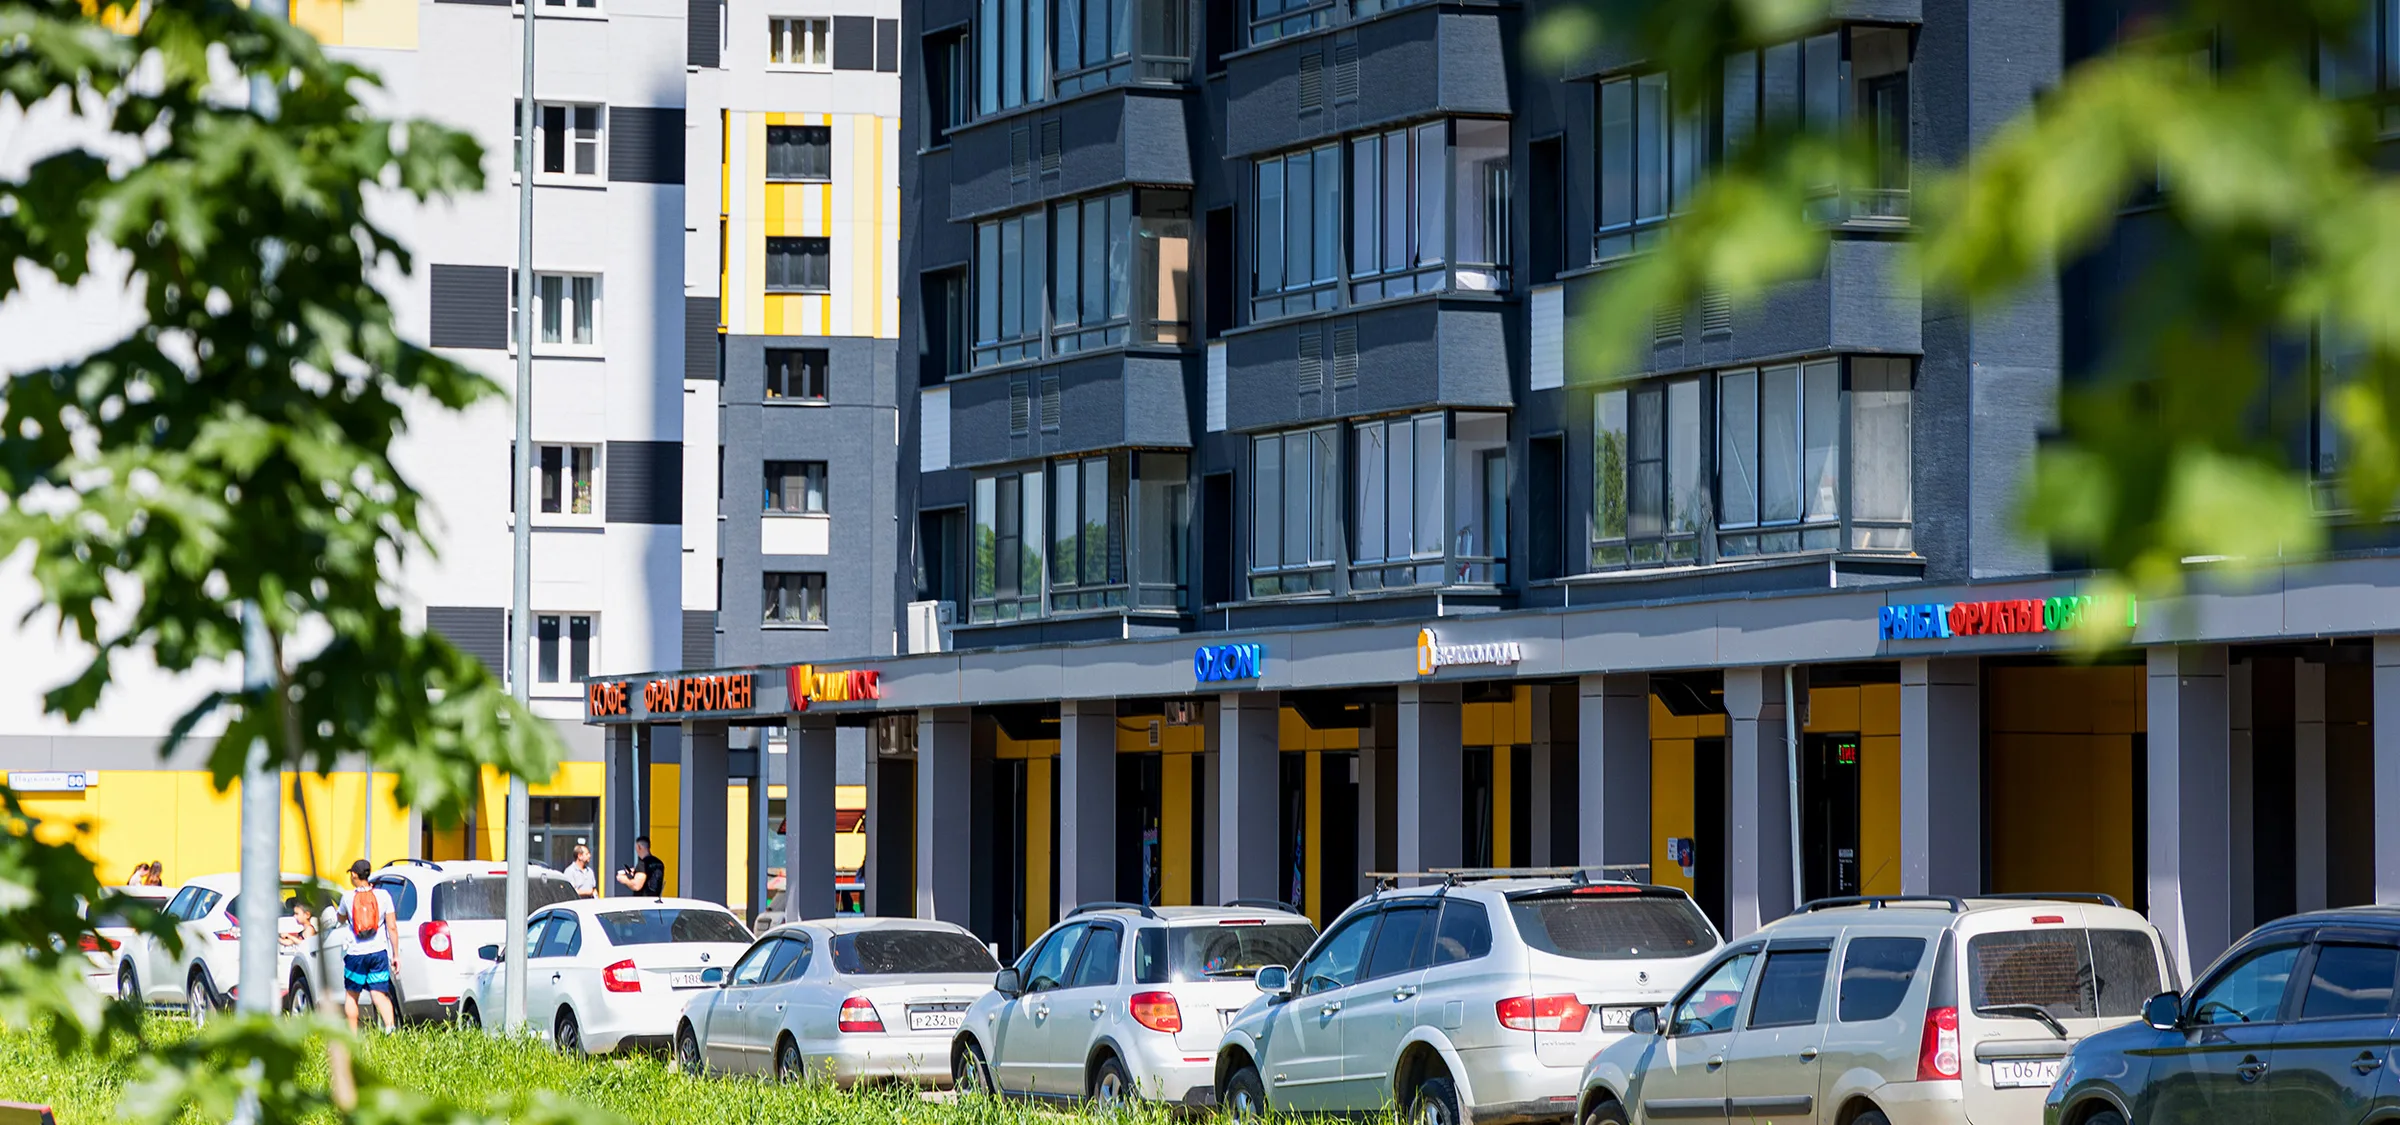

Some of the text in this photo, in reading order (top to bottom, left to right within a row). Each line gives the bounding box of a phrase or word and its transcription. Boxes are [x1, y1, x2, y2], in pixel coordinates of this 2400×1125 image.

[1878, 594, 2137, 640] РЫБА ФРУКТЫ ОВО
[1193, 643, 1261, 682] OZON
[589, 674, 752, 716] КОФЕ ФРАУ БРОТХЕН
